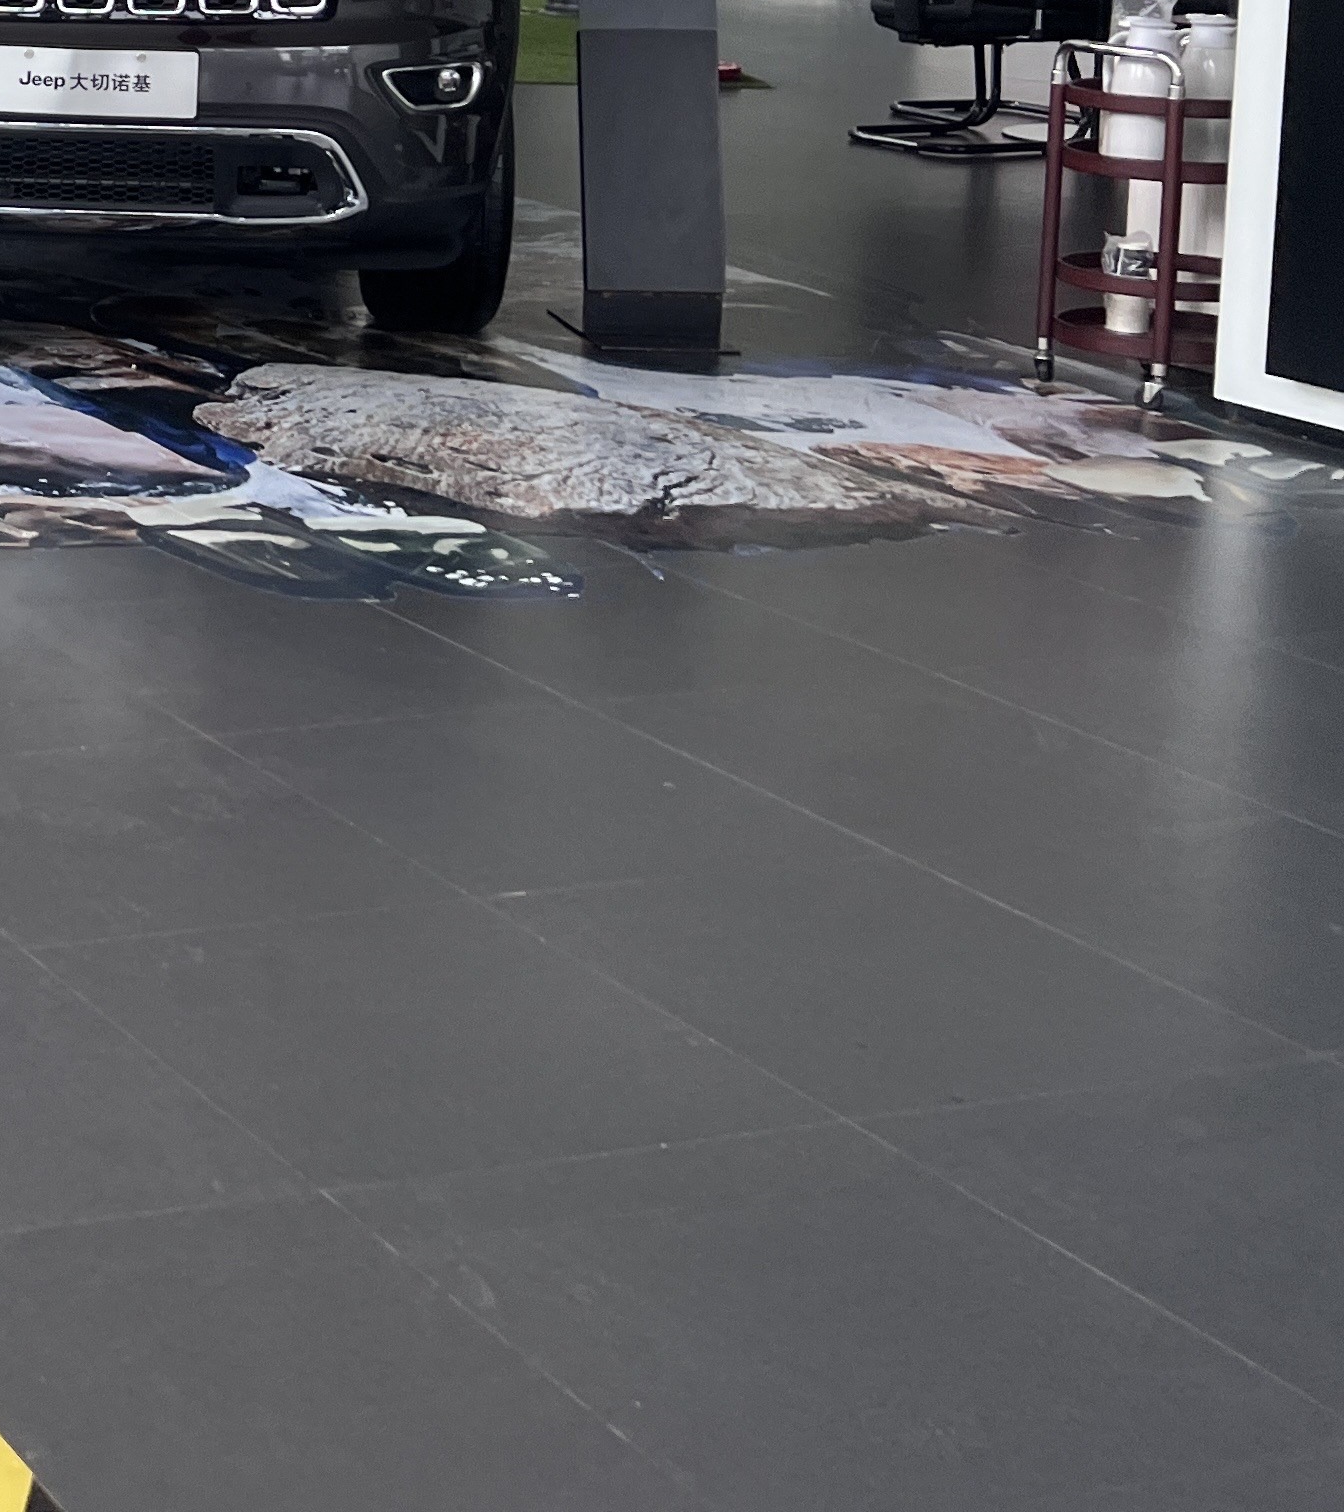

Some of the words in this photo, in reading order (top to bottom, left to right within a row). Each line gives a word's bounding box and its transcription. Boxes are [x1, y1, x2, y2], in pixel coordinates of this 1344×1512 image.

[19, 71, 66, 90] Jeep
[70, 73, 152, 92] 大切诺基
